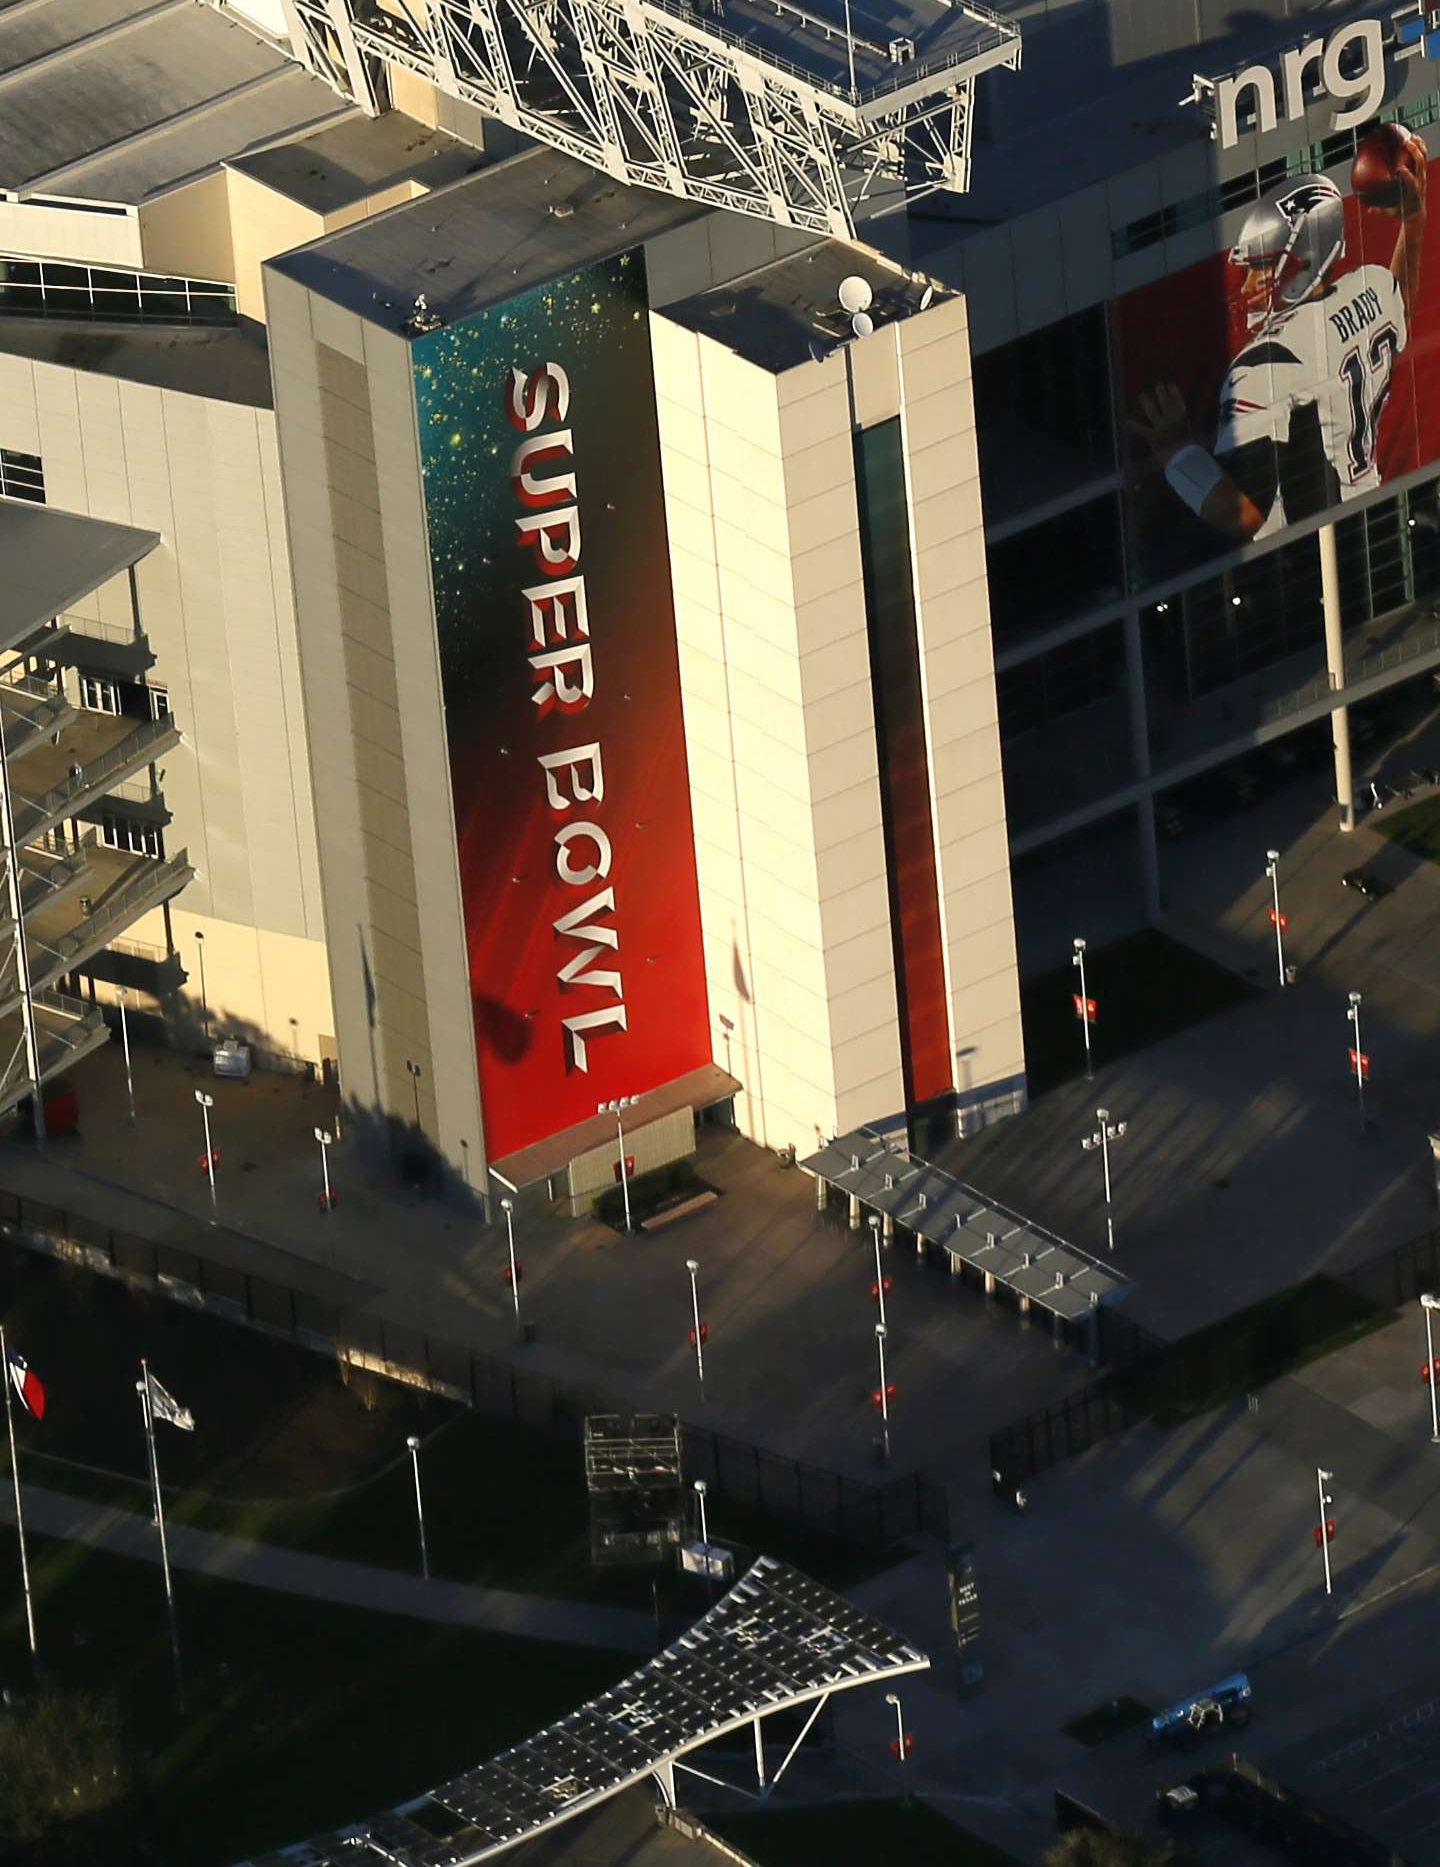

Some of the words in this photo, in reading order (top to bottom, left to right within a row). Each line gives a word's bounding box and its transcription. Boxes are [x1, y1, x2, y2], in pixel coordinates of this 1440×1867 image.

[1213, 18, 1387, 150] nrg
[1329, 287, 1384, 343] BRADY
[506, 362, 596, 720] SUPER
[537, 742, 628, 1076] BOWL
